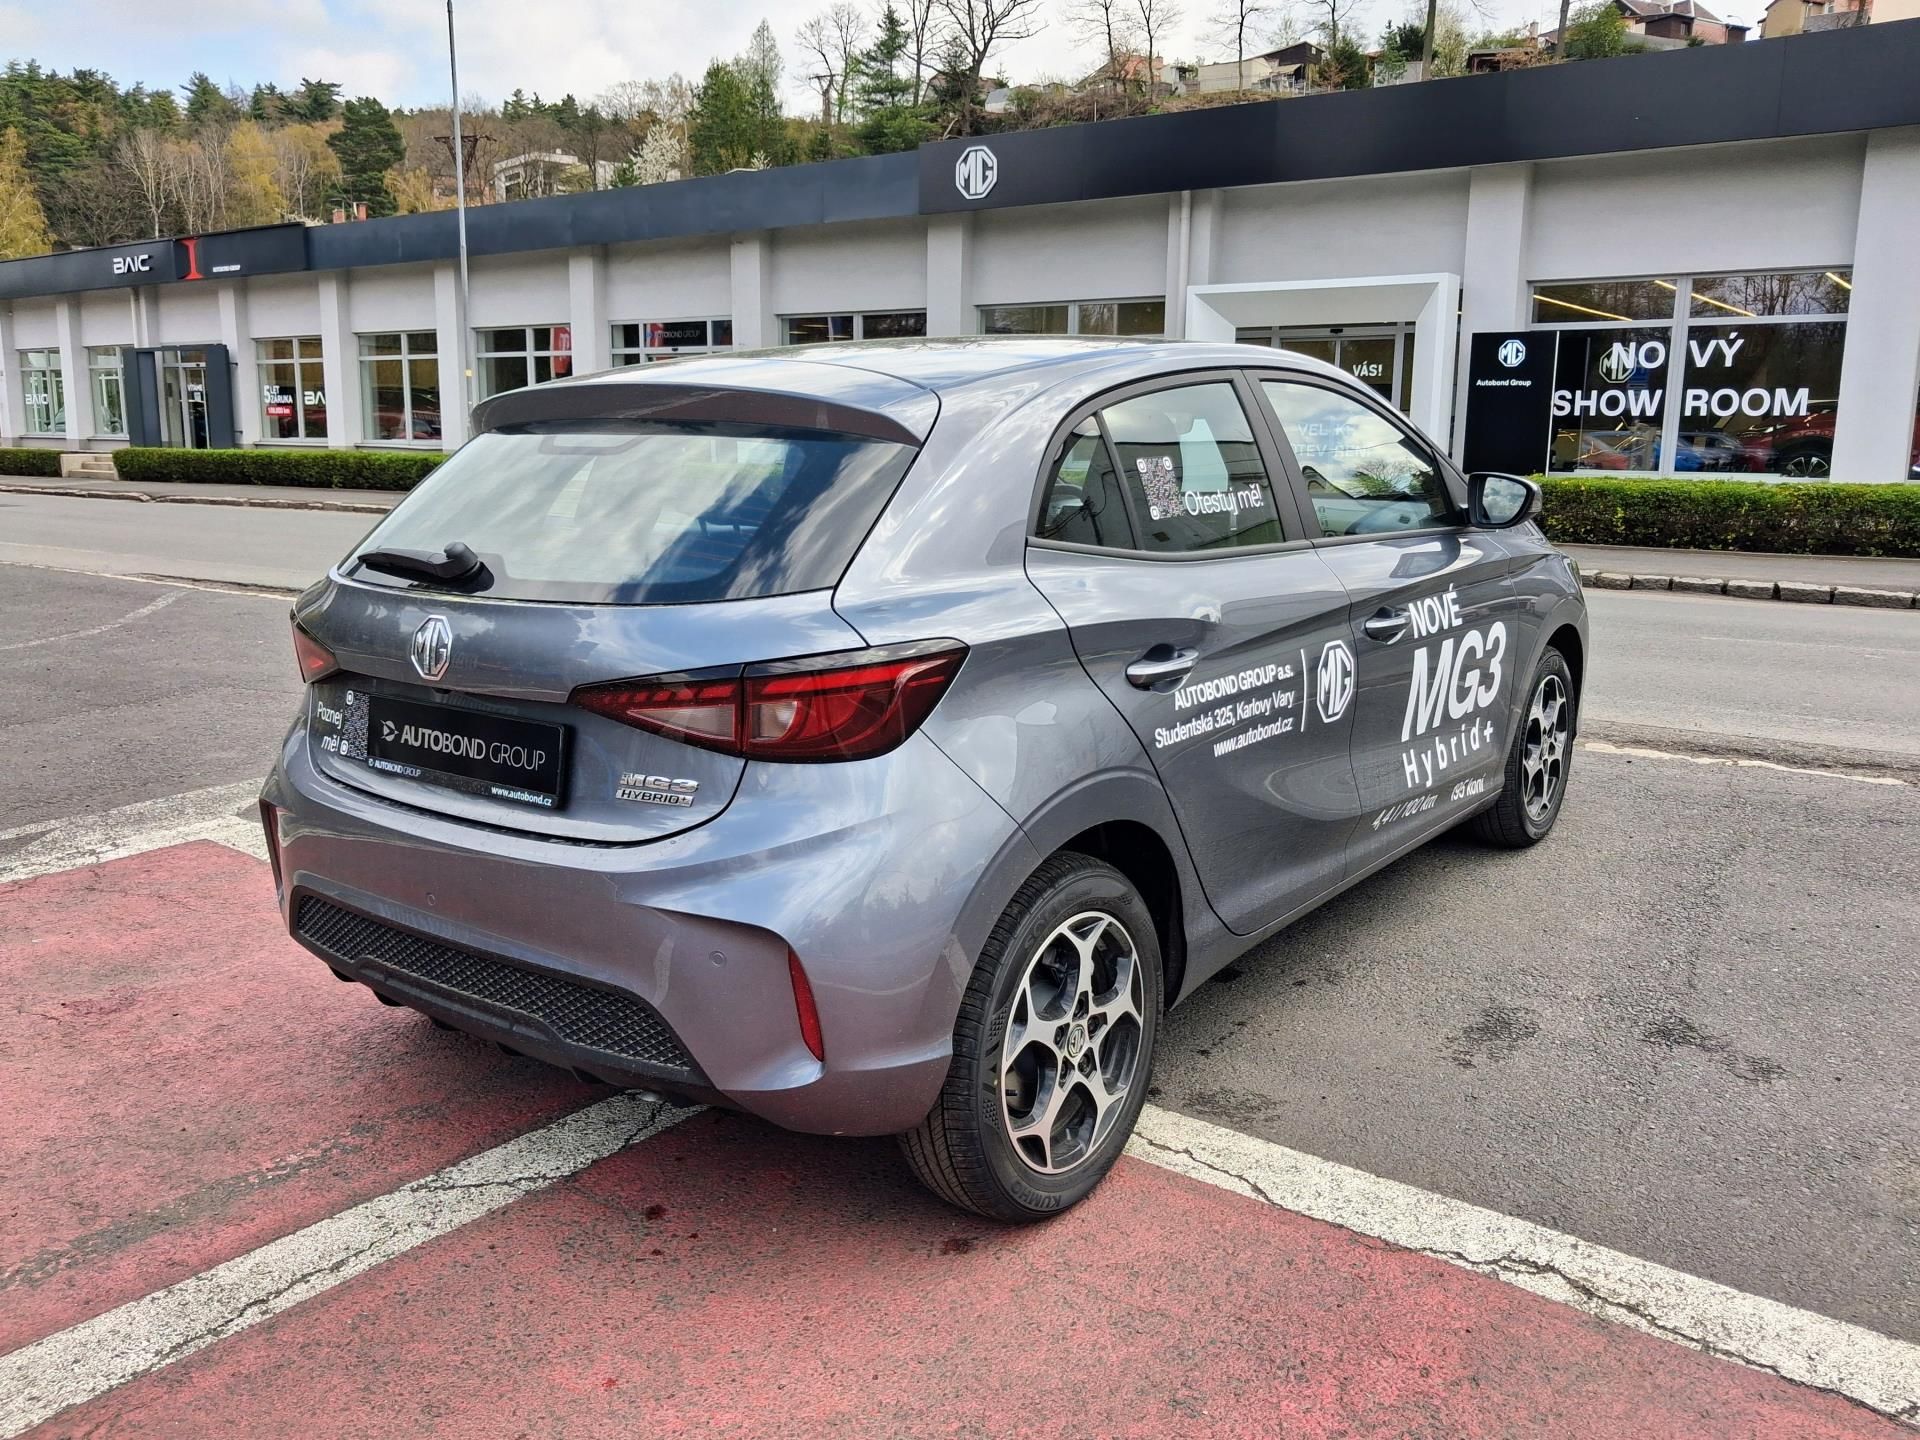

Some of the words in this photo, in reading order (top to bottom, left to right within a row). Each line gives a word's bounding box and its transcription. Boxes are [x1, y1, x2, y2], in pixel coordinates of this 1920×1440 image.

[957, 147, 996, 198] MG
[112, 254, 150, 274] BAIC
[1499, 340, 1525, 366] MG
[1352, 360, 1383, 377] VÁS!
[1476, 378, 1509, 387] Autobond
[1510, 378, 1532, 388] Group
[25, 393, 49, 405] BAIC
[263, 385, 271, 404] 5
[303, 391, 327, 405] BA
[1553, 388, 1663, 417] SHOW
[1684, 387, 1810, 417] ROOM
[1184, 487, 1239, 516] Otestuj
[1237, 483, 1264, 509] mě!
[1408, 583, 1463, 639] NOVÉ
[412, 616, 451, 679] MG
[1174, 675, 1238, 711] AUTOBOND
[1238, 664, 1277, 691] GROUP
[1277, 664, 1294, 680] a.s.
[1318, 641, 1353, 721] MG
[1401, 621, 1507, 742] MG3
[316, 700, 343, 729] Poznej
[1154, 711, 1214, 749] Studentská
[1214, 705, 1236, 728] 325,
[1236, 698, 1273, 722] Karlovy
[1272, 690, 1295, 709] Vary
[320, 734, 340, 753] mě!
[400, 724, 486, 760] AUTOBOND
[489, 742, 546, 772] GROUP
[1213, 716, 1294, 758] www.autobond.cz
[1402, 717, 1495, 788] Hybrid+
[490, 785, 553, 807] www.autobond.cz
[620, 771, 699, 793] MG3
